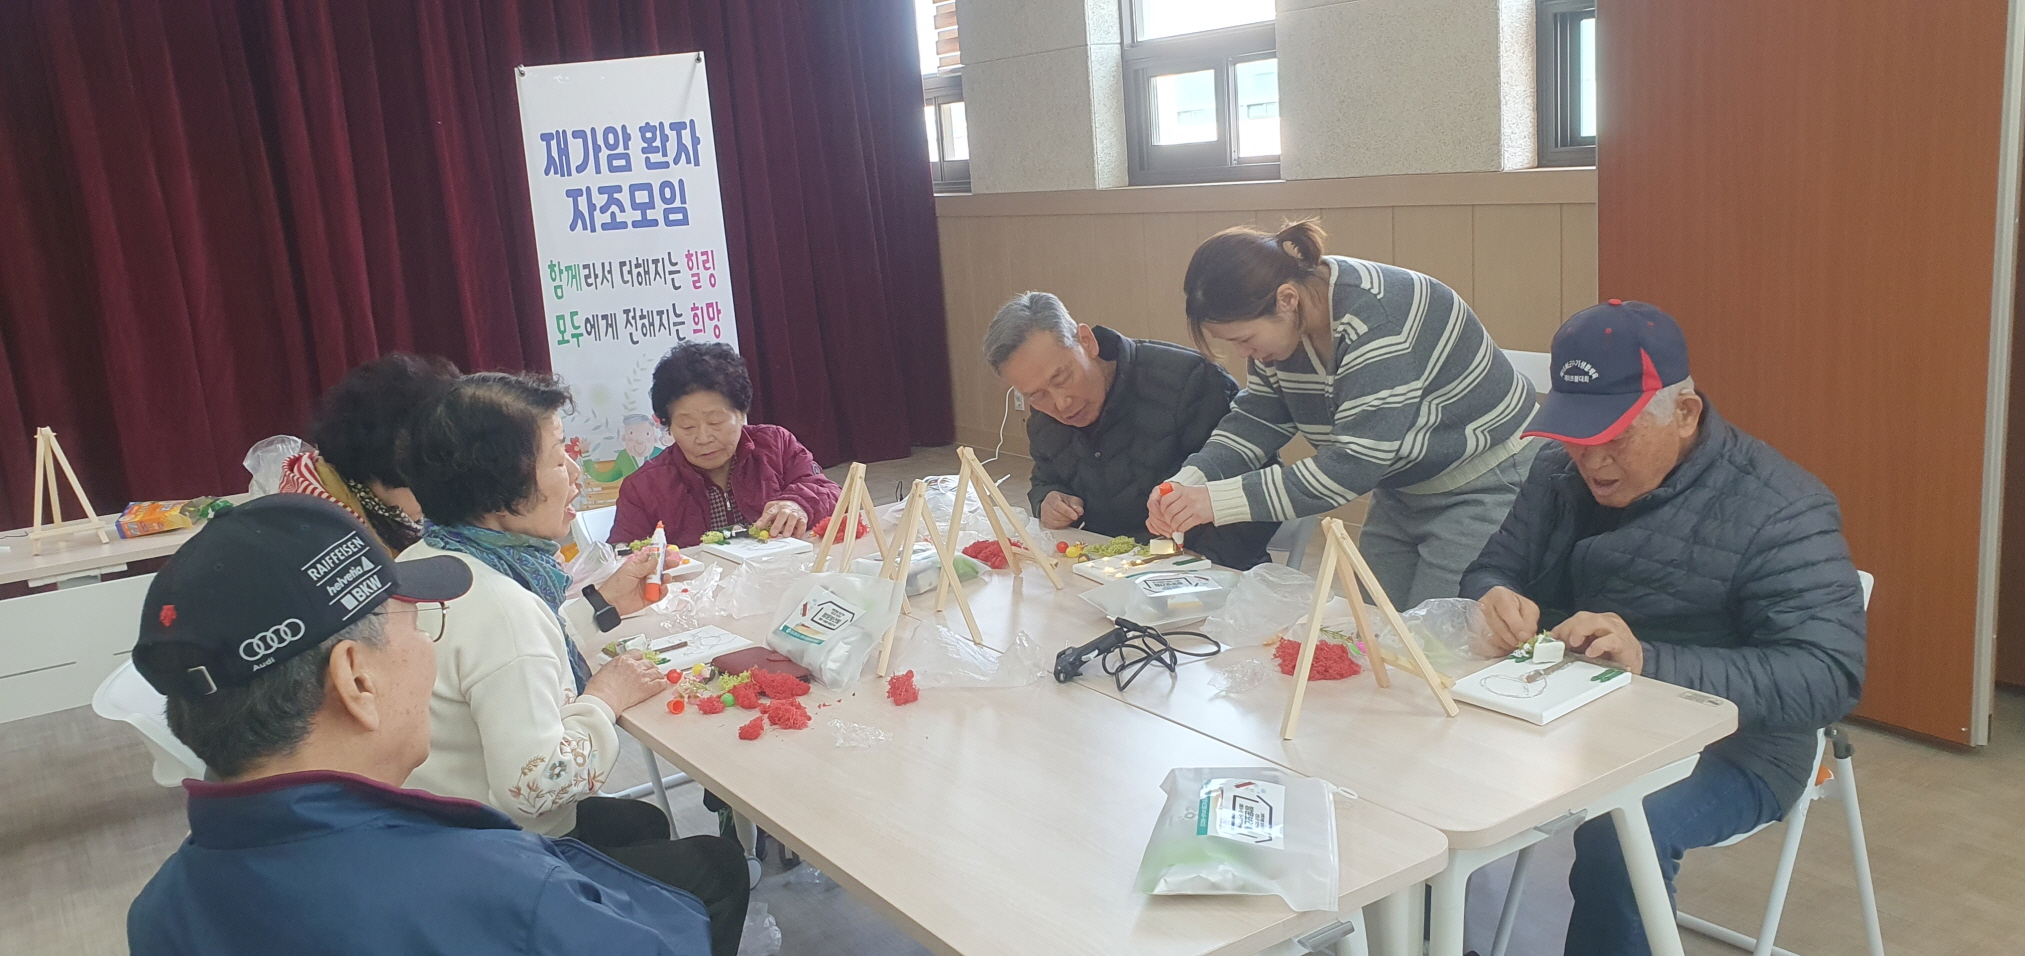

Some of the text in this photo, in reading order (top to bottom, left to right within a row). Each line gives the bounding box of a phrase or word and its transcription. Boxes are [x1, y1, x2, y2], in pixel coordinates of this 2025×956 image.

[540, 119, 701, 177] 재가암 환자
[565, 179, 690, 233] 자조모임
[548, 249, 716, 300] 함께라서 더해지는 힐링
[555, 301, 722, 348] 모두에게 전해지는 희망
[307, 536, 365, 581] RAIFFEISEN
[326, 565, 364, 596] helvetia
[351, 574, 382, 601] BKW
[252, 656, 275, 671] Audi
